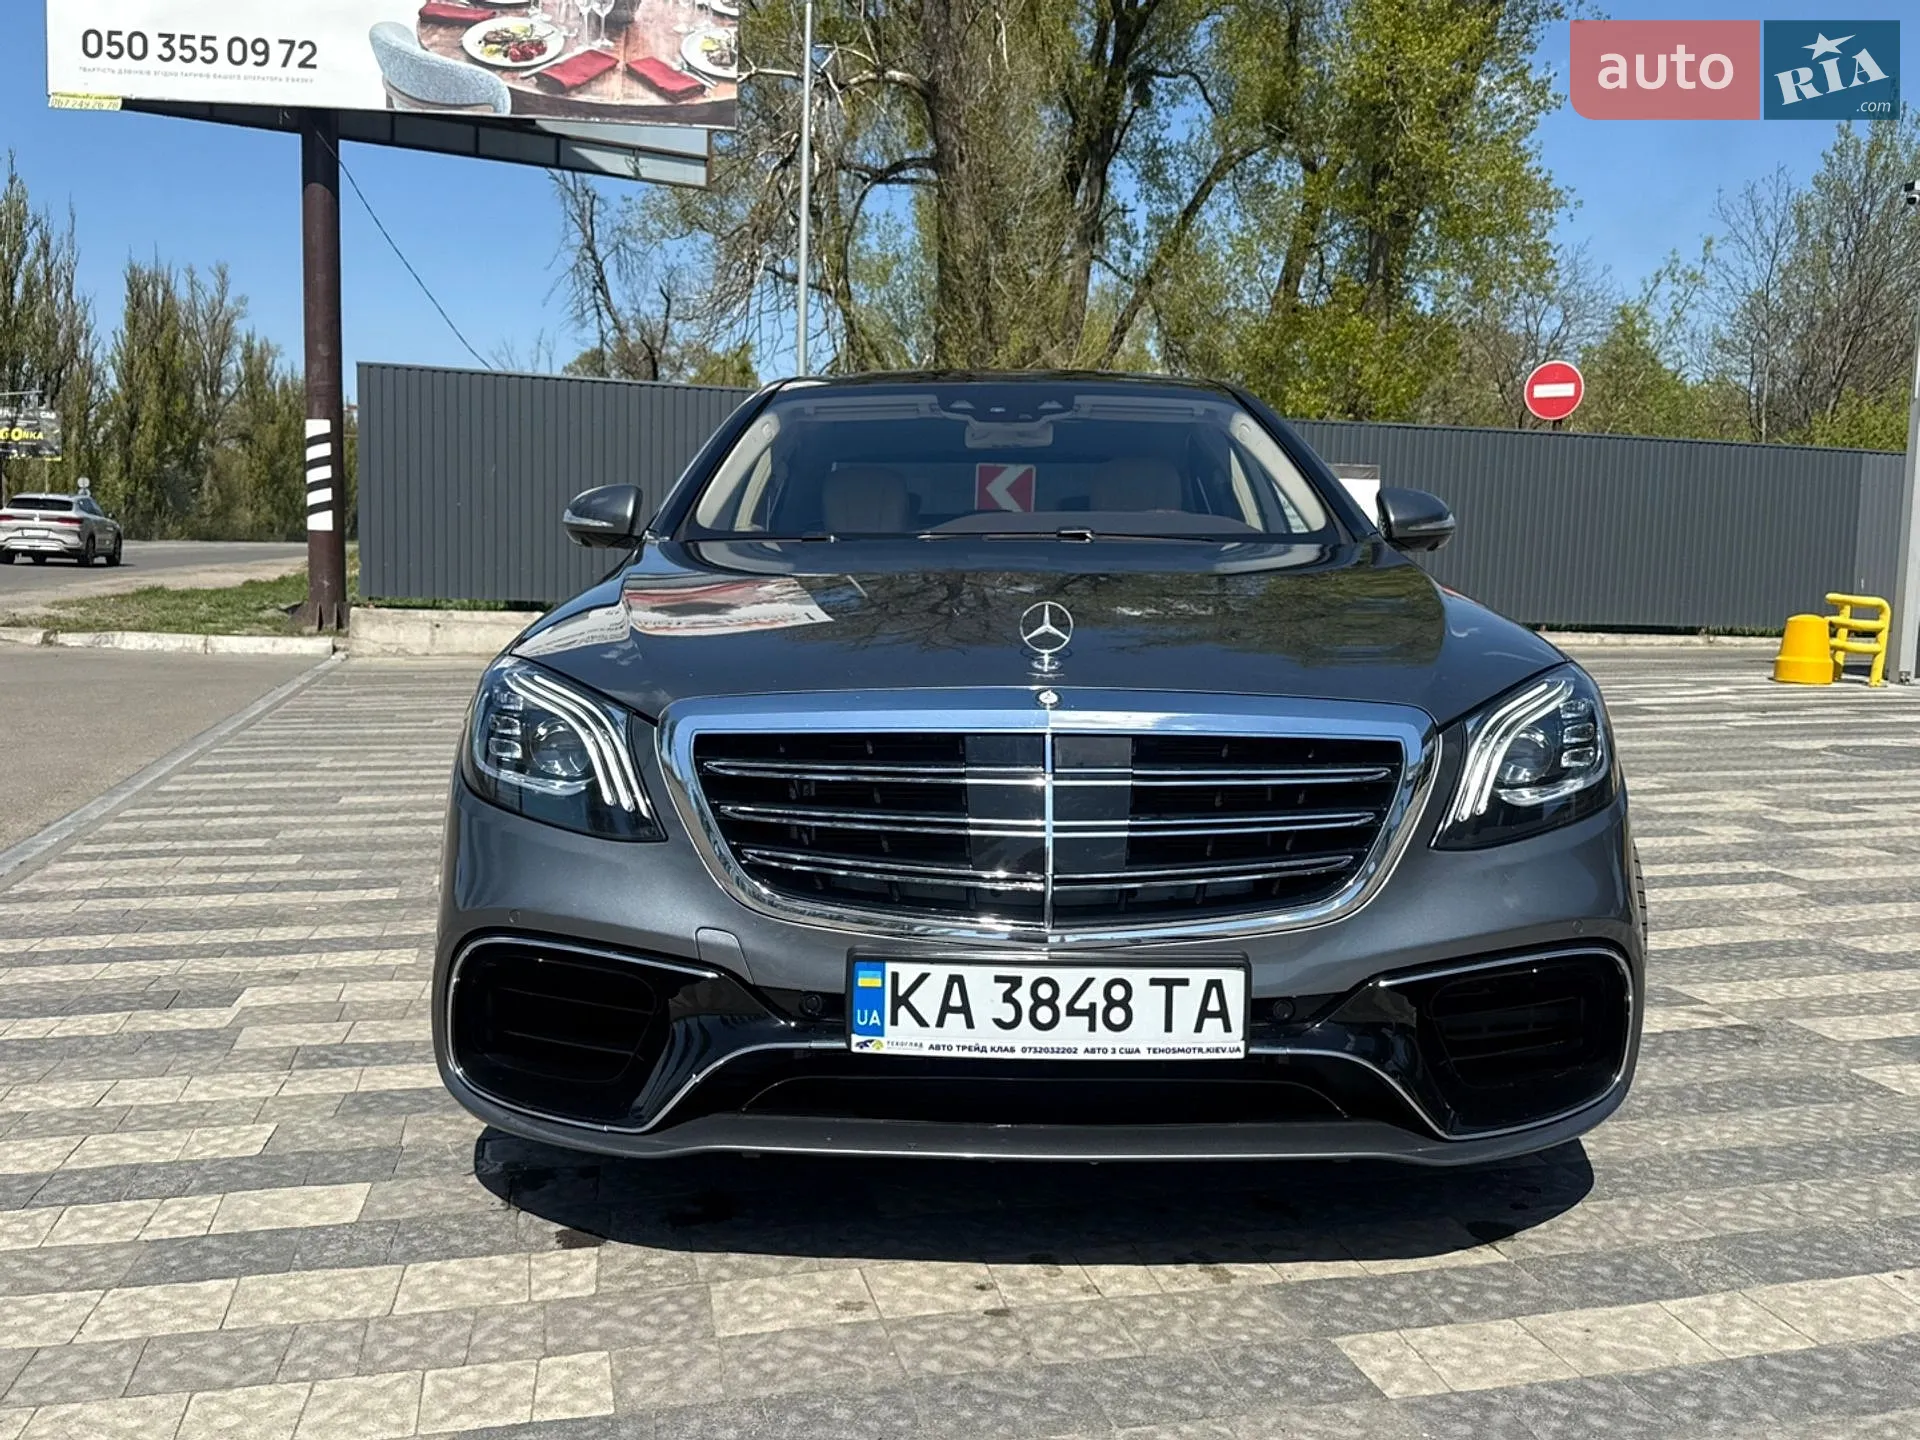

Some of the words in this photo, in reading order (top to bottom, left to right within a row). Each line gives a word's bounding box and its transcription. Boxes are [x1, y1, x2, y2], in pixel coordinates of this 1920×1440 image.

[82, 29, 148, 61] 050
[157, 33, 219, 64] 355
[227, 36, 270, 67] 09
[278, 38, 317, 70] 72
[890, 971, 975, 1030] KA
[991, 974, 1133, 1033] 3848
[1149, 977, 1232, 1034] TA
[857, 1009, 881, 1026] UA
[928, 1043, 953, 1052] АВТО
[956, 1044, 988, 1054] ТРЕЙД
[990, 1046, 1016, 1054] КЛАБ
[1083, 1047, 1109, 1055] АВТО
[1118, 1047, 1141, 1055] США
